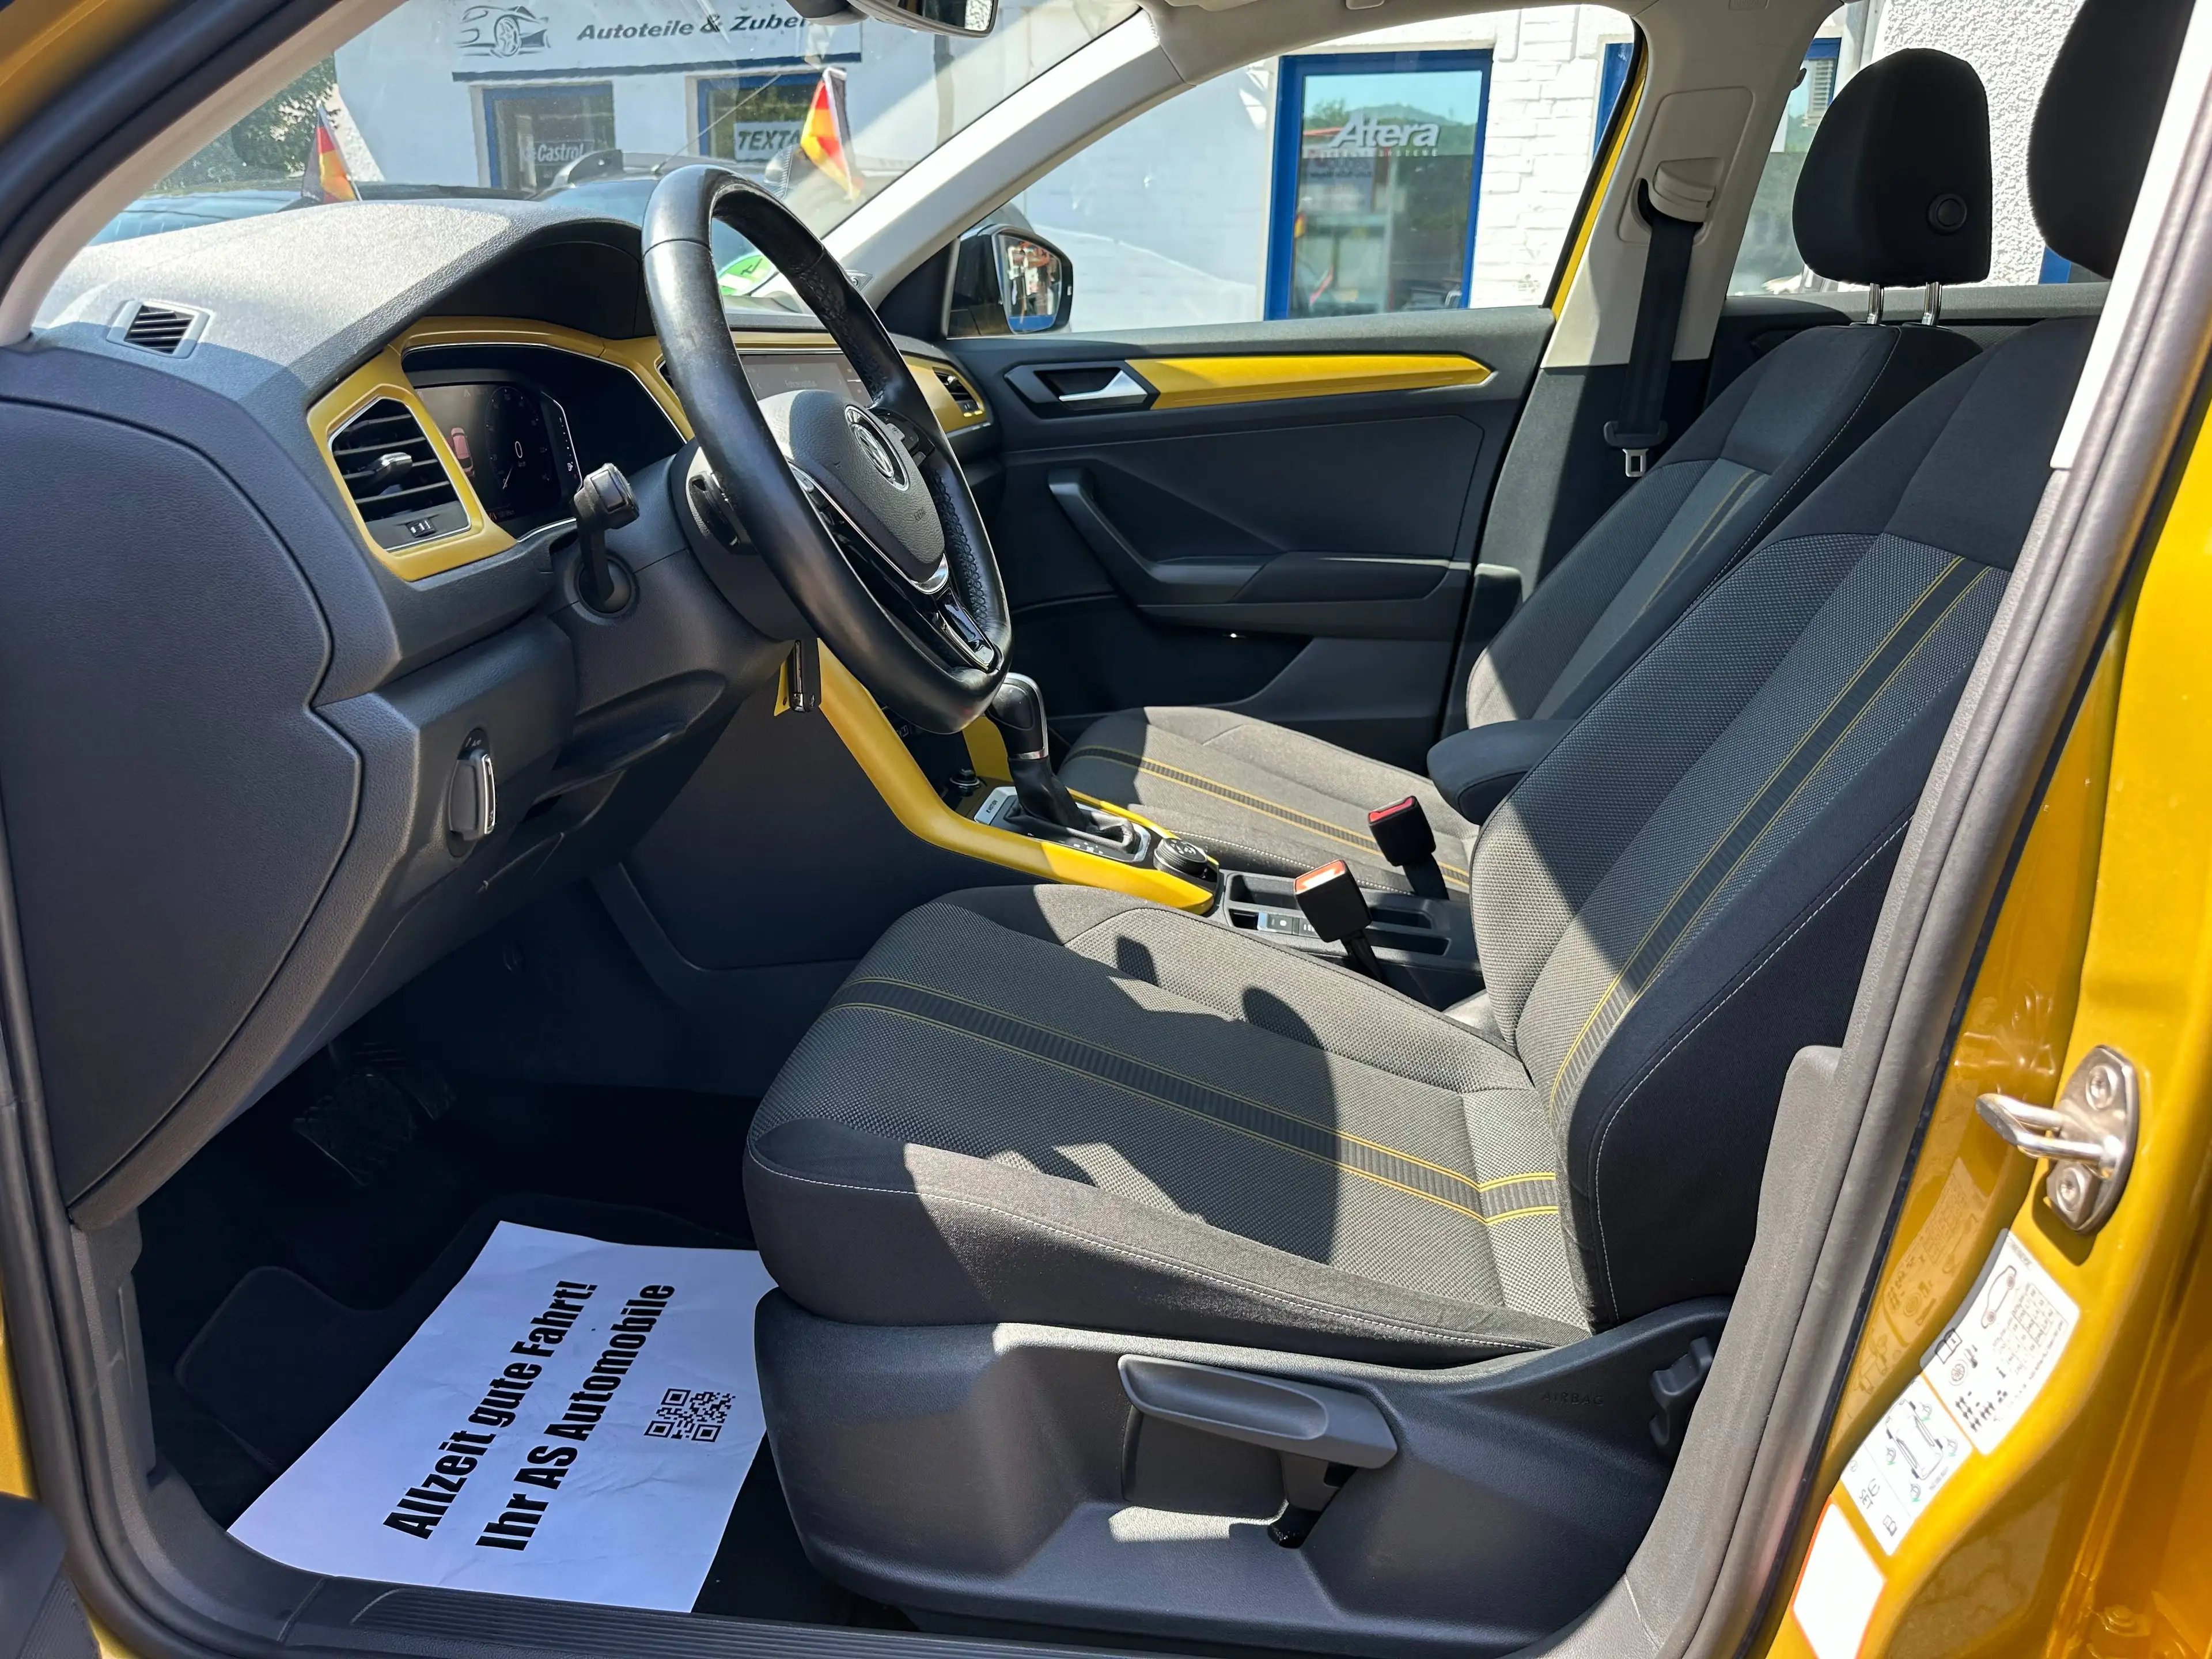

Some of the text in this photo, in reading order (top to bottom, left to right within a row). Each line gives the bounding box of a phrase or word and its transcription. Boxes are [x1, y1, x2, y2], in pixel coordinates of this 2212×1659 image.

[577, 20, 694, 41] Autoteile
[700, 14, 720, 33] &
[1328, 111, 1441, 148] Atera
[538, 142, 585, 162] Castrol
[383, 1280, 598, 1540] Allzeit gute Fahrt!
[1541, 1391, 1604, 1407] AIRBAG
[475, 1284, 675, 1551] Ihr AS Automobile
